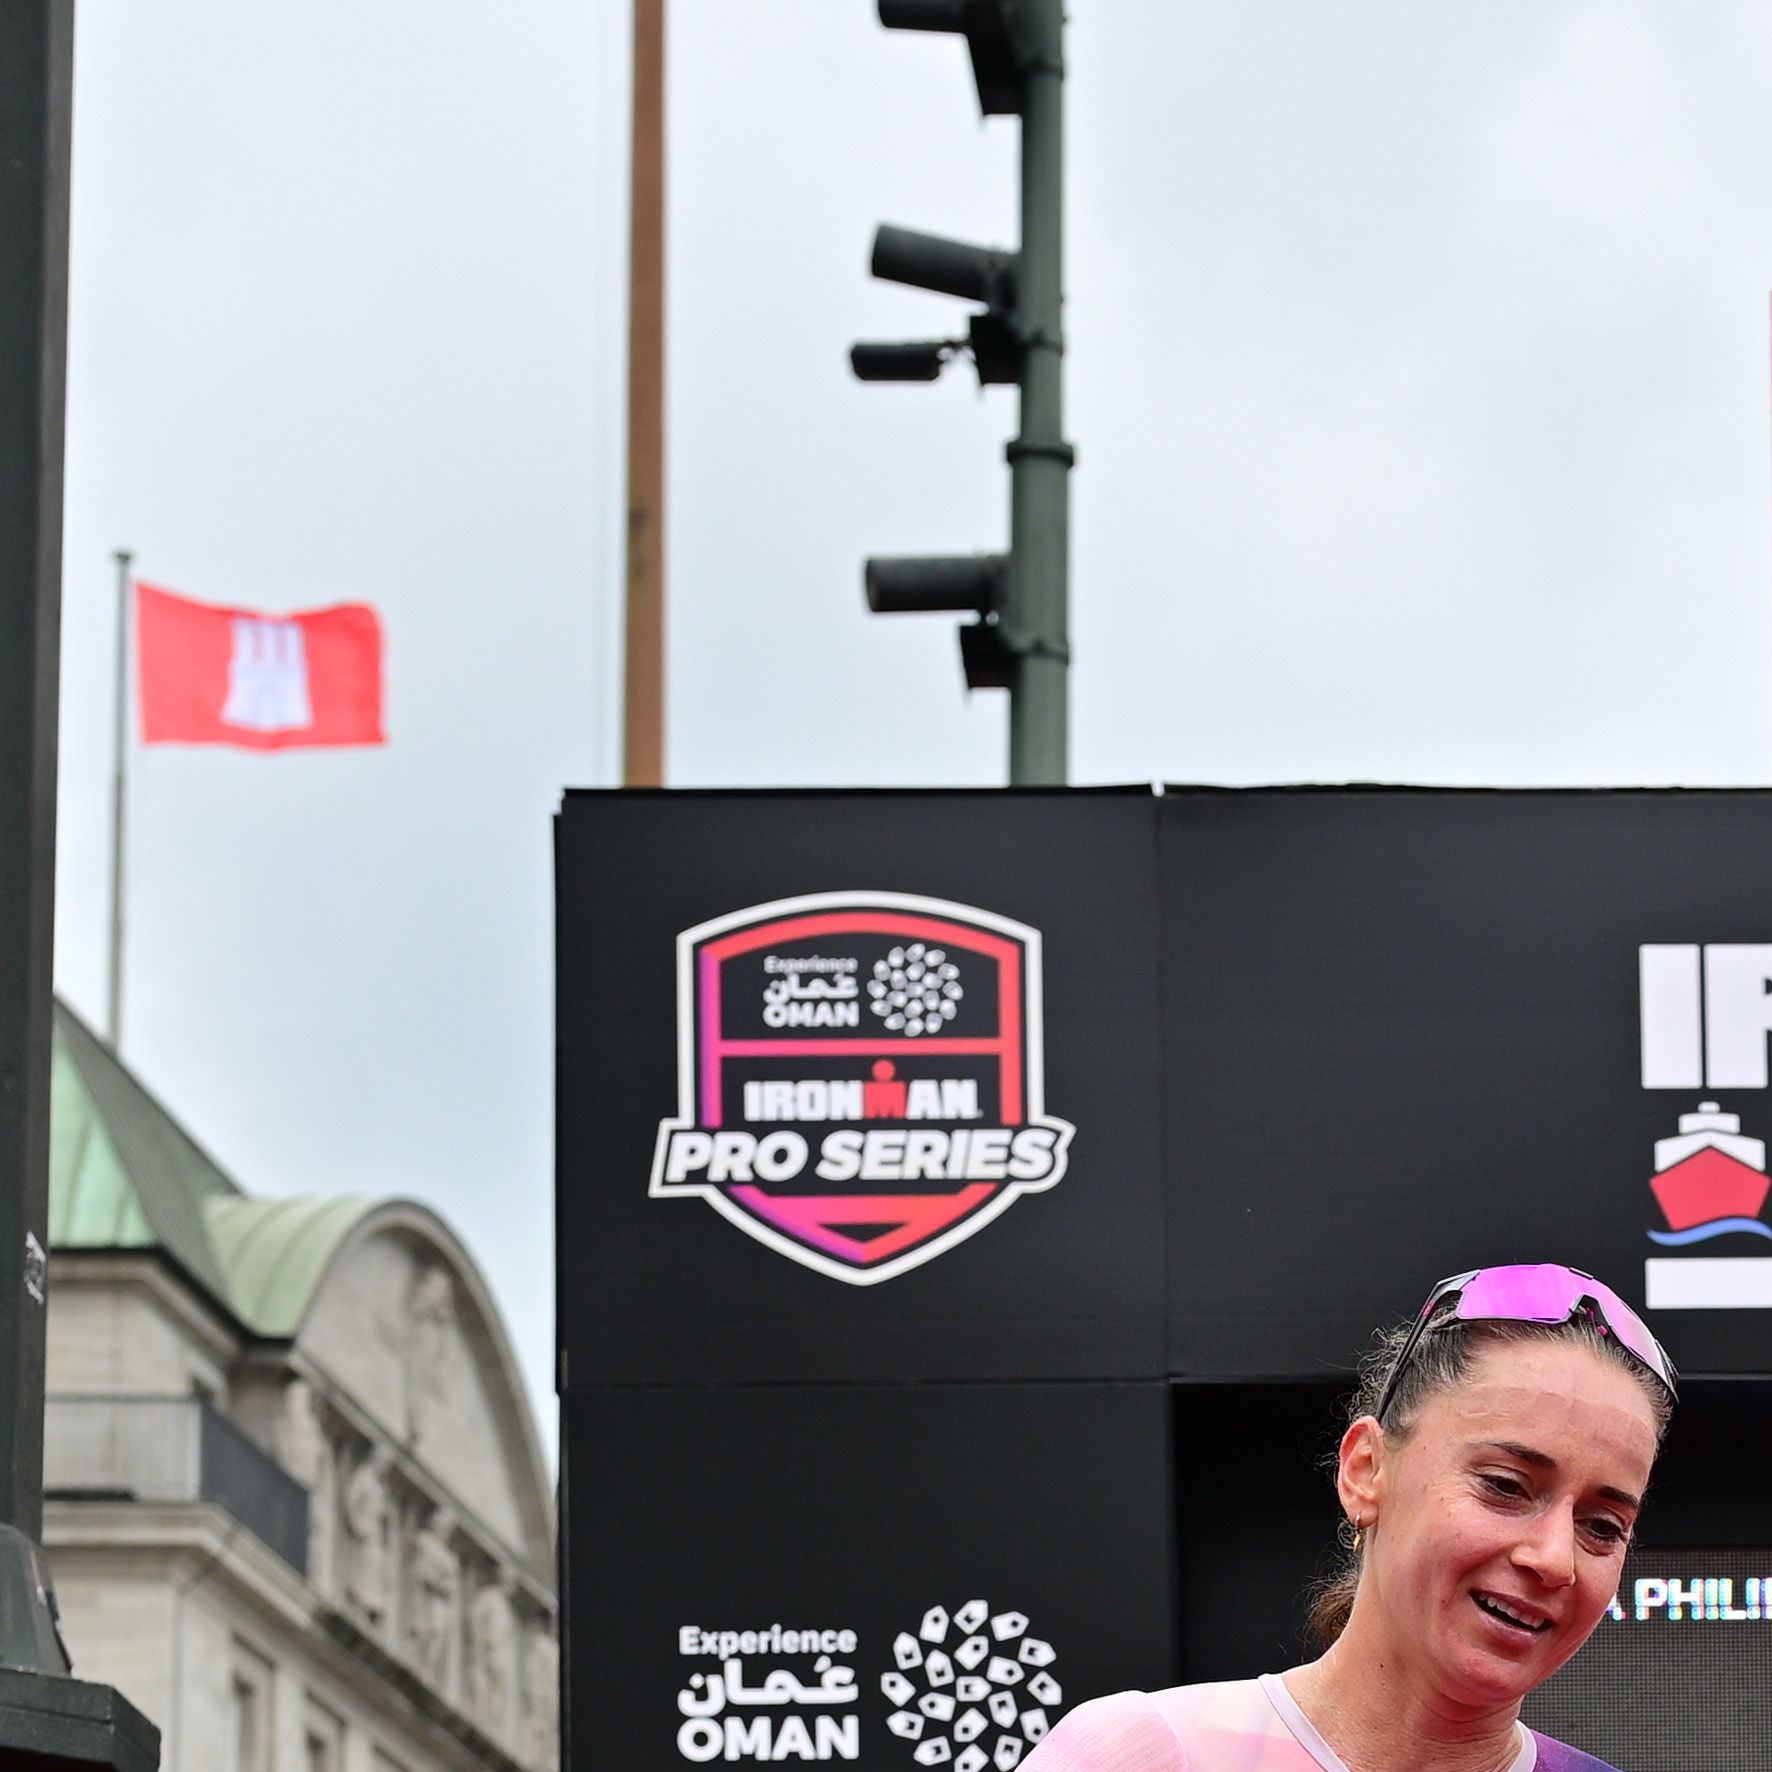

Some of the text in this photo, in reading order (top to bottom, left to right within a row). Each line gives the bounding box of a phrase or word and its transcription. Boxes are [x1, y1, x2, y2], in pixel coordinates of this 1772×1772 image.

[764, 956, 857, 975] Experience
[763, 1002, 858, 1028] OMAN
[745, 1080, 978, 1121] IRONMAN
[666, 1129, 1057, 1182] PRO SERIES
[679, 1624, 858, 1661] Experience
[677, 1714, 860, 1763] OMAN
